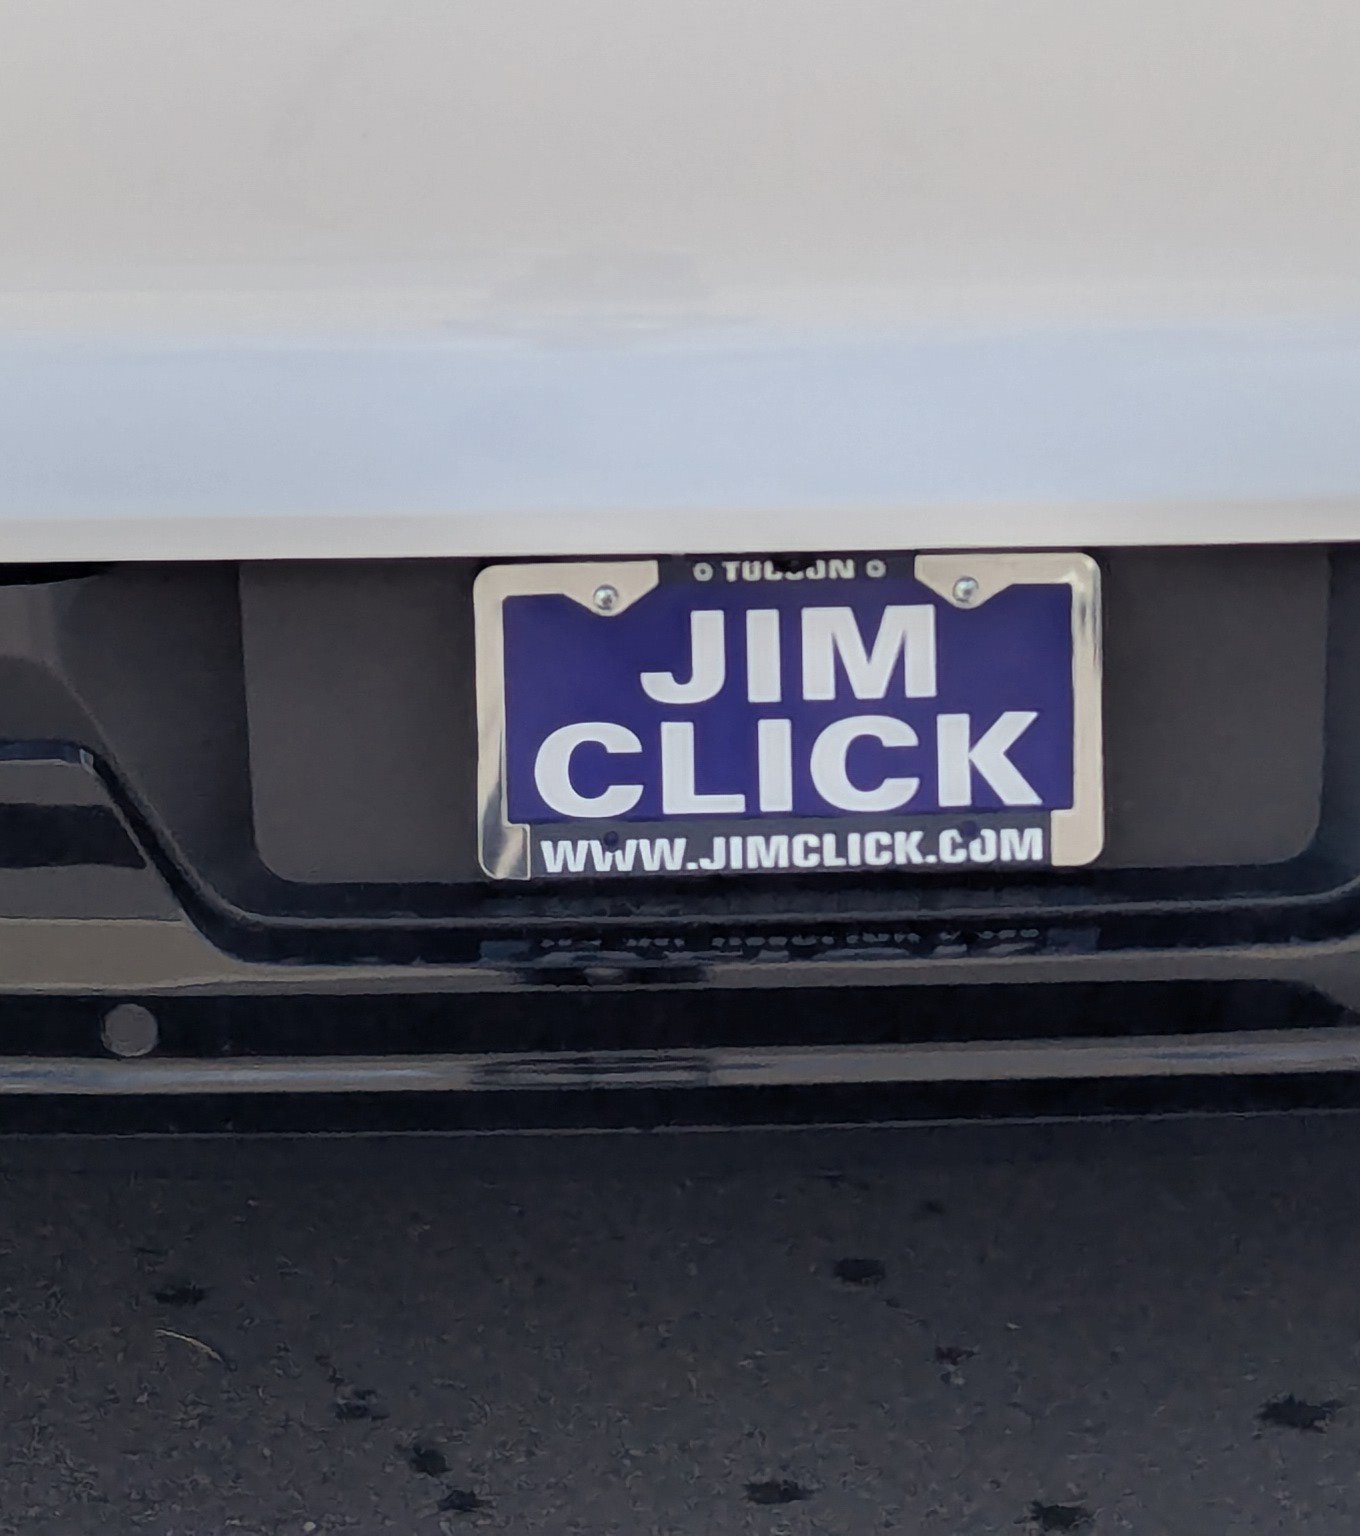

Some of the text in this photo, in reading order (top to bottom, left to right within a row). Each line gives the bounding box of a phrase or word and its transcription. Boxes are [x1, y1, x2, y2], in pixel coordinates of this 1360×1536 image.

[640, 605, 937, 704] JIM
[534, 711, 1043, 818] CLICK
[540, 827, 1044, 873] WWW.JIMCLICK.COM
